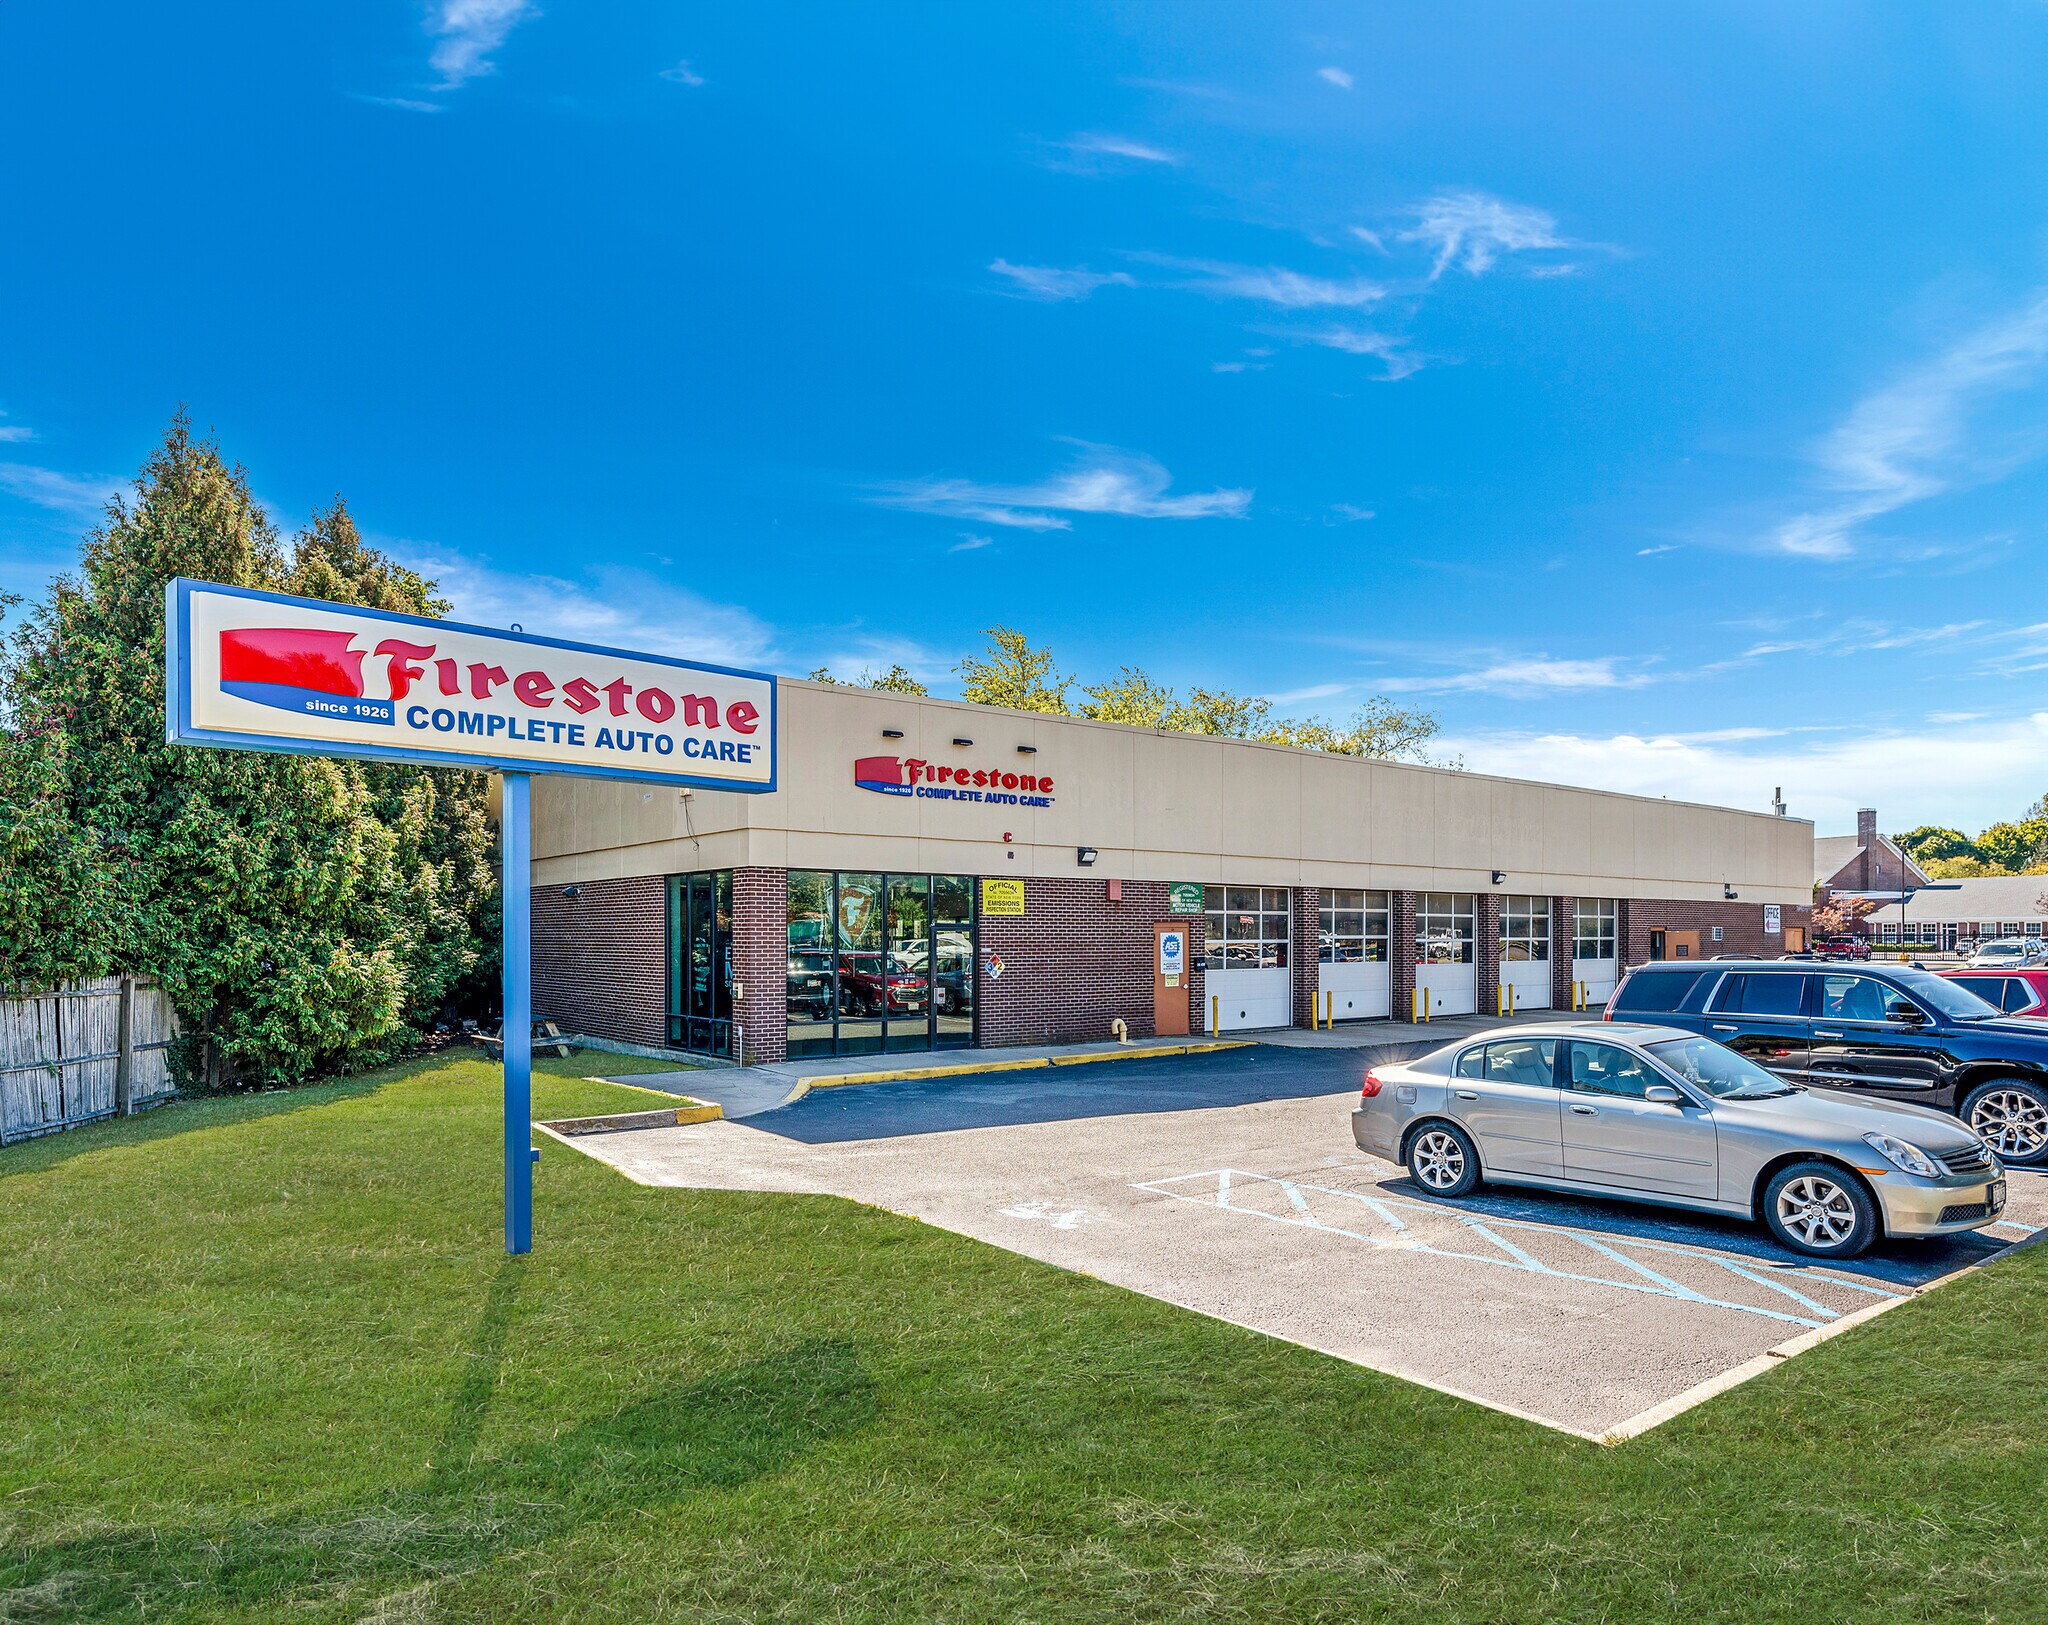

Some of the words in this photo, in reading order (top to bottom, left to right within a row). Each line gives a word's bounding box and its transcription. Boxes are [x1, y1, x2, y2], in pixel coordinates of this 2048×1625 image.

[373, 639, 760, 734] Firestone
[305, 699, 348, 715] since
[353, 702, 389, 719] 1926
[406, 705, 585, 747] COMPLETE
[594, 727, 674, 756] AUTO
[904, 758, 1054, 793] Firestone
[916, 786, 983, 803] COMPLETE
[985, 792, 1018, 805] AUTO
[988, 881, 1018, 894] OFFICIAL
